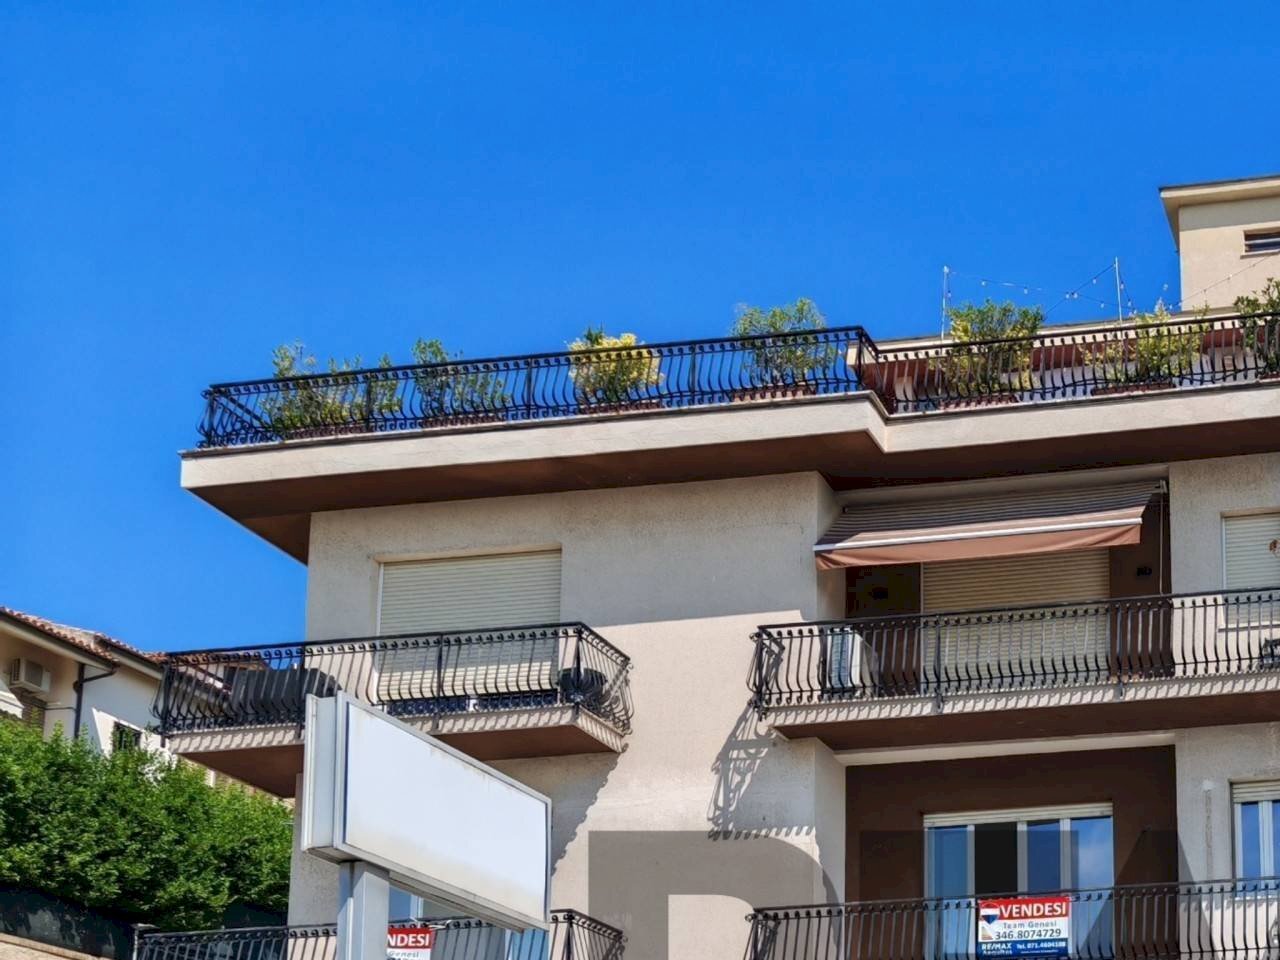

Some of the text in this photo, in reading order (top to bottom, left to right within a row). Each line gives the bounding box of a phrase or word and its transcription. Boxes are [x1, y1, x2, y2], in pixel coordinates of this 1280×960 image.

[1000, 902, 1066, 918] VENDESI
[387, 933, 430, 947] NDESI
[995, 928, 1061, 940] 346.8074729
